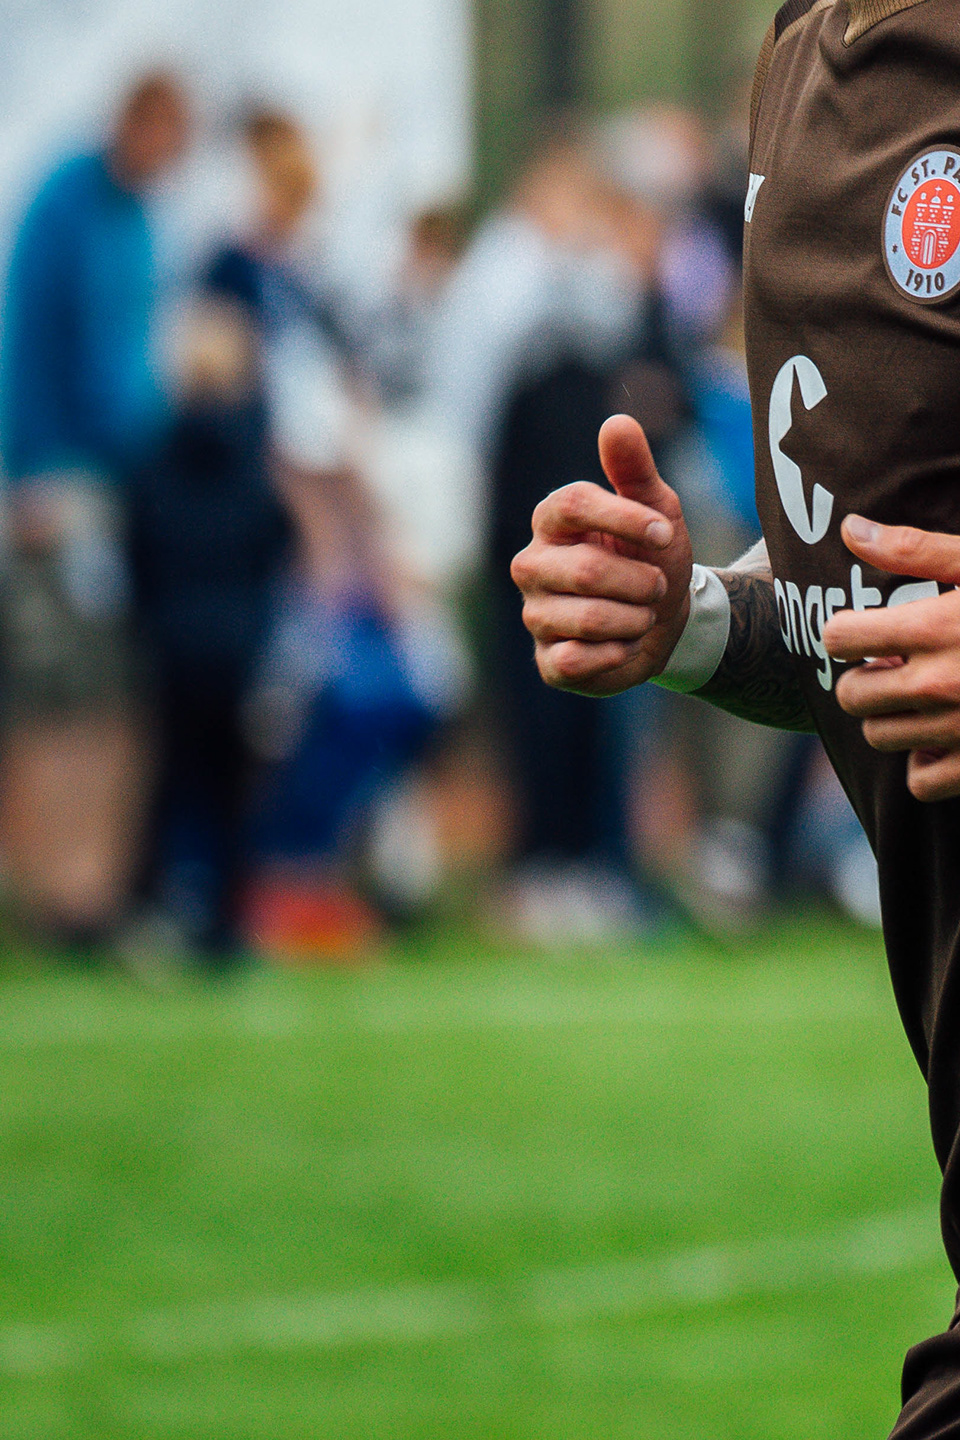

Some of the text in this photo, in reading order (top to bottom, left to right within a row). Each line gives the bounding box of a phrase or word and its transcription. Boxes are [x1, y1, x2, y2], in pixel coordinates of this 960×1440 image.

[891, 187, 908, 217] FC
[910, 158, 936, 186] ST.
[905, 268, 945, 294] 1910
